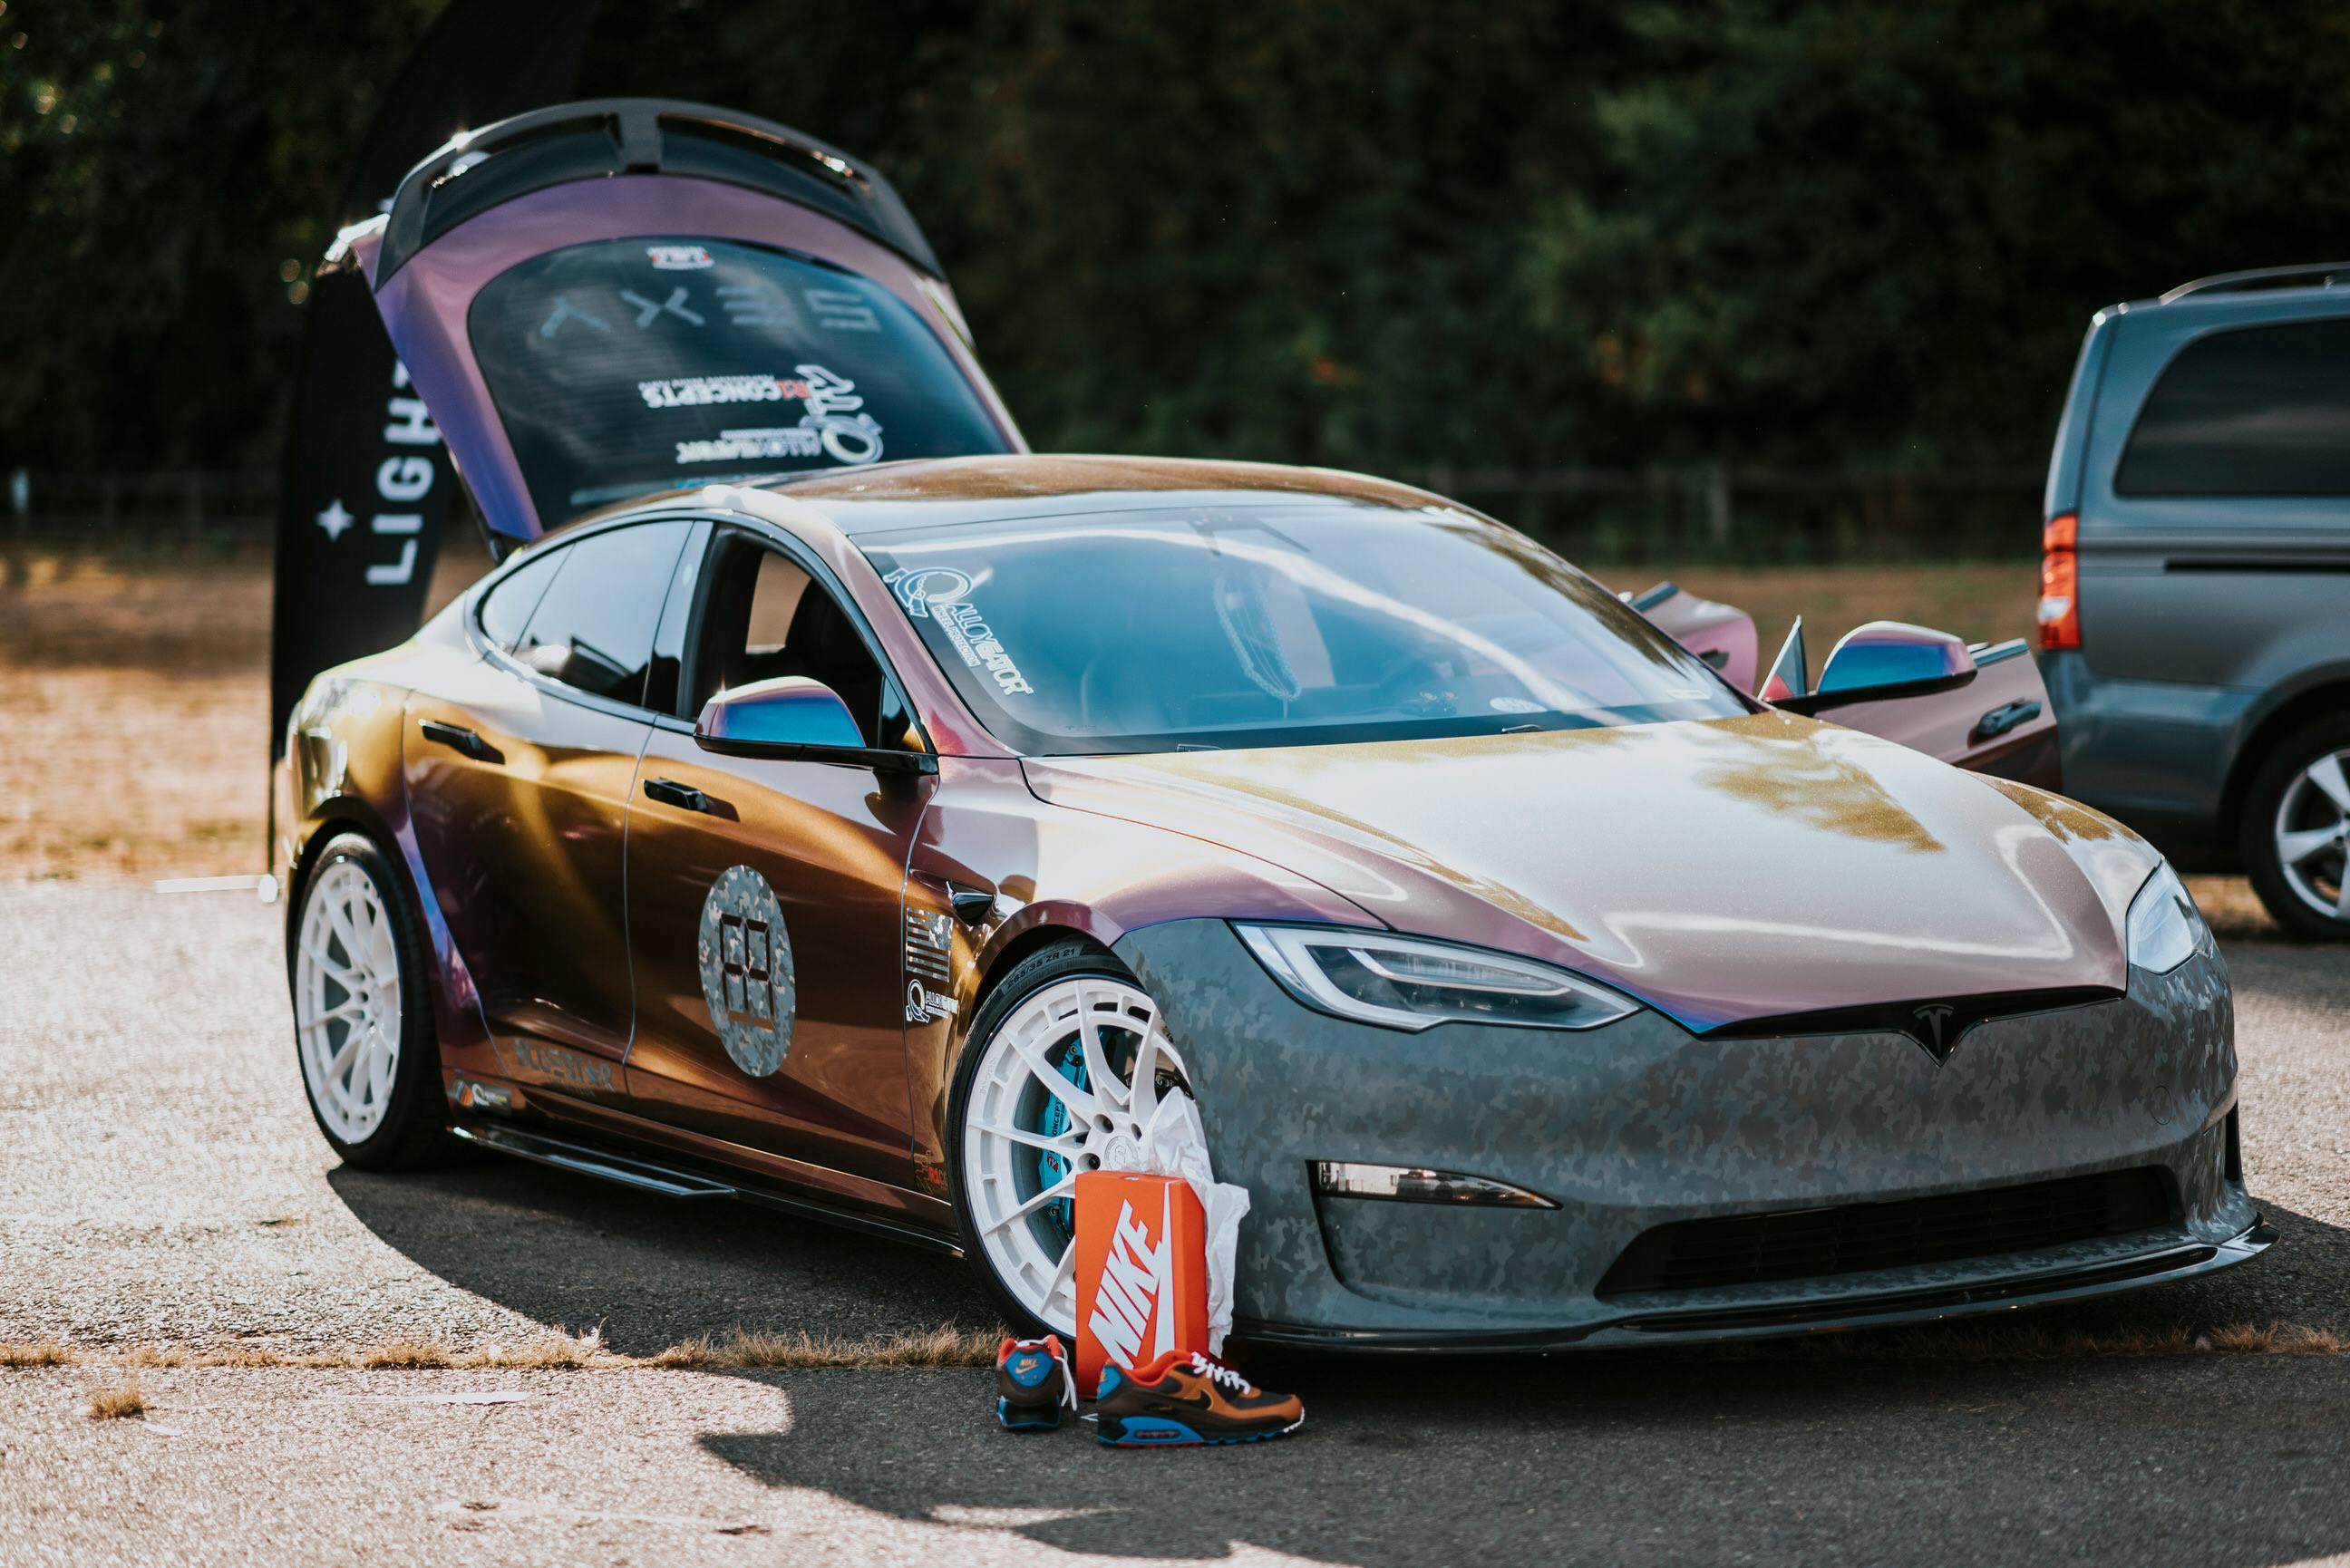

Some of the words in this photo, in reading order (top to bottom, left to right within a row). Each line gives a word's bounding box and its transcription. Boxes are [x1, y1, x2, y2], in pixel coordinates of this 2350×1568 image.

[366, 360, 442, 586] LIGH
[1045, 952, 1060, 963] ZR
[1063, 947, 1076, 958] 21
[1088, 1197, 1163, 1370] NIKE
